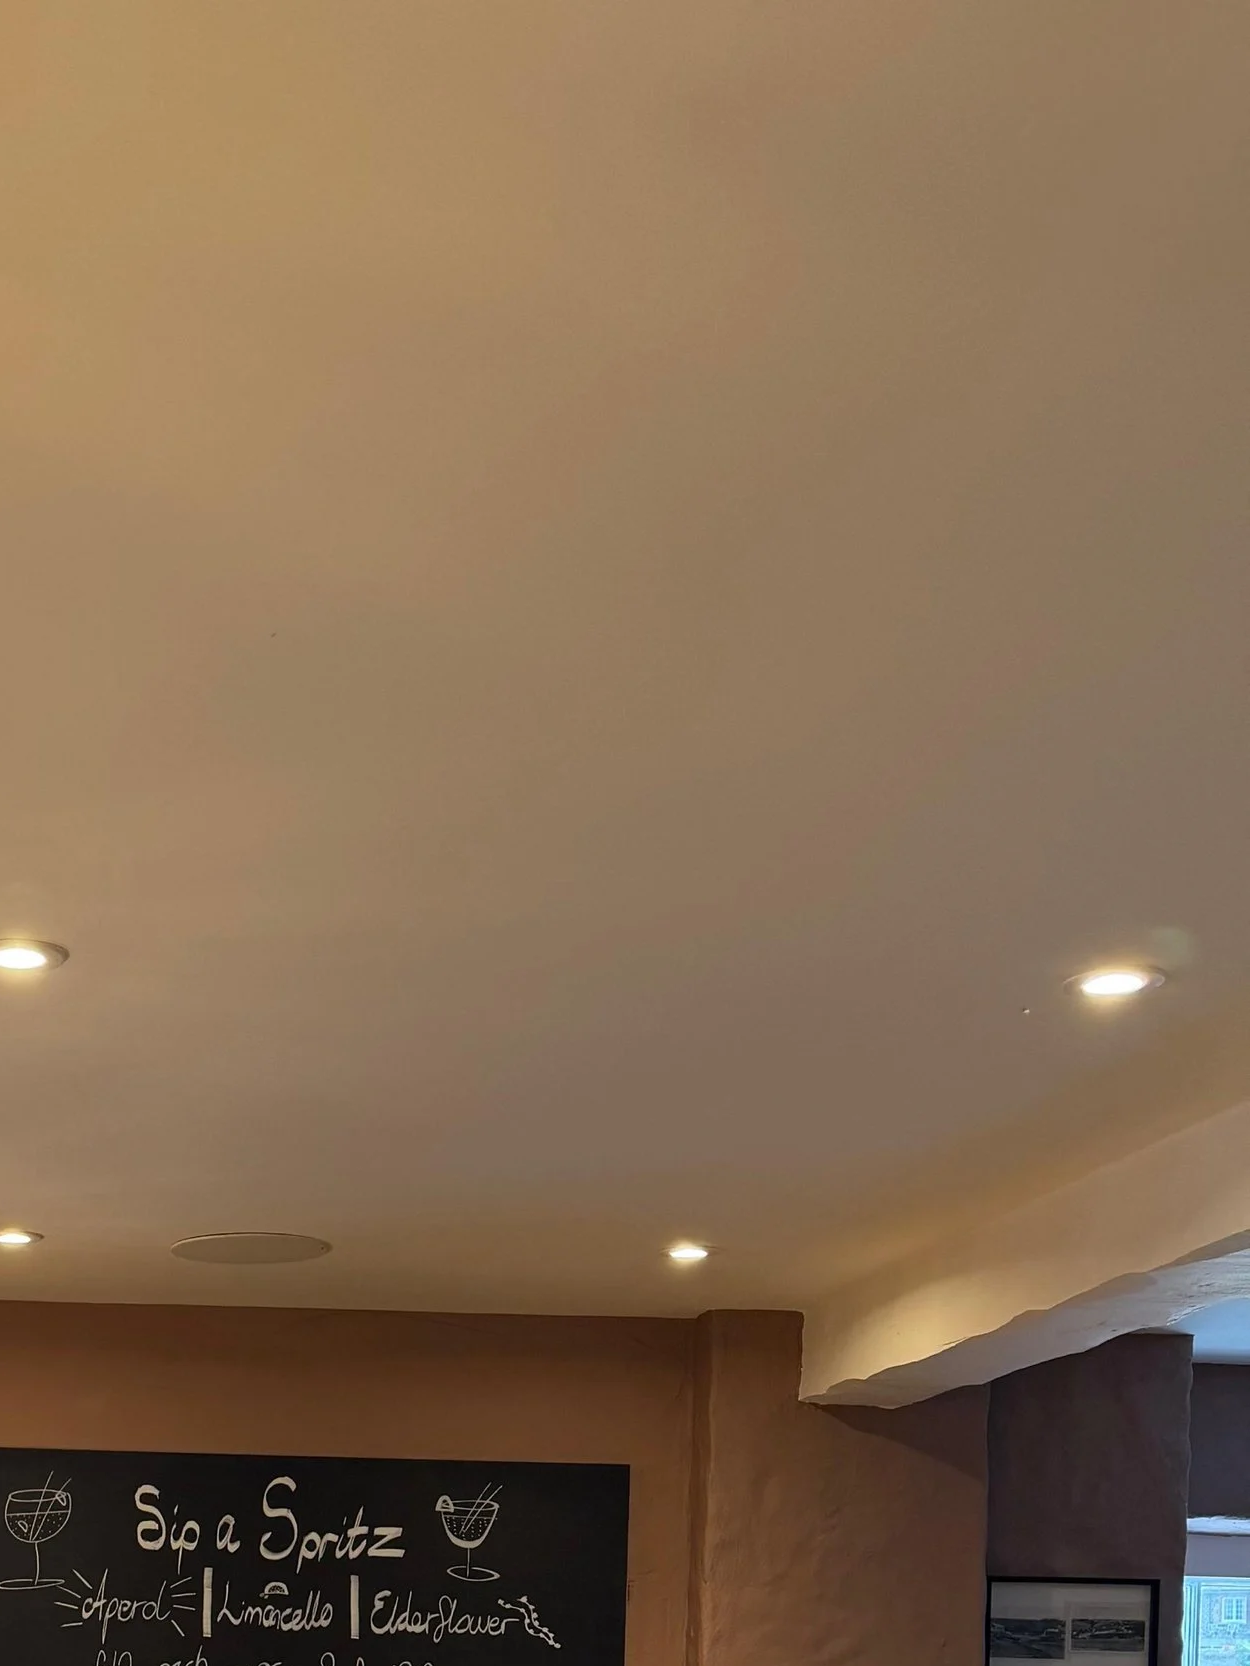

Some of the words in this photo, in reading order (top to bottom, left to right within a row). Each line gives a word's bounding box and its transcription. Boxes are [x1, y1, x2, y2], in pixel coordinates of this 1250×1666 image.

[134, 1483, 200, 1575] Sip
[216, 1514, 241, 1553] a
[259, 1476, 406, 1574] Spritz
[81, 1568, 172, 1644] Aperol
[217, 1580, 333, 1632] Limoncello
[370, 1589, 520, 1643] Elderflower
